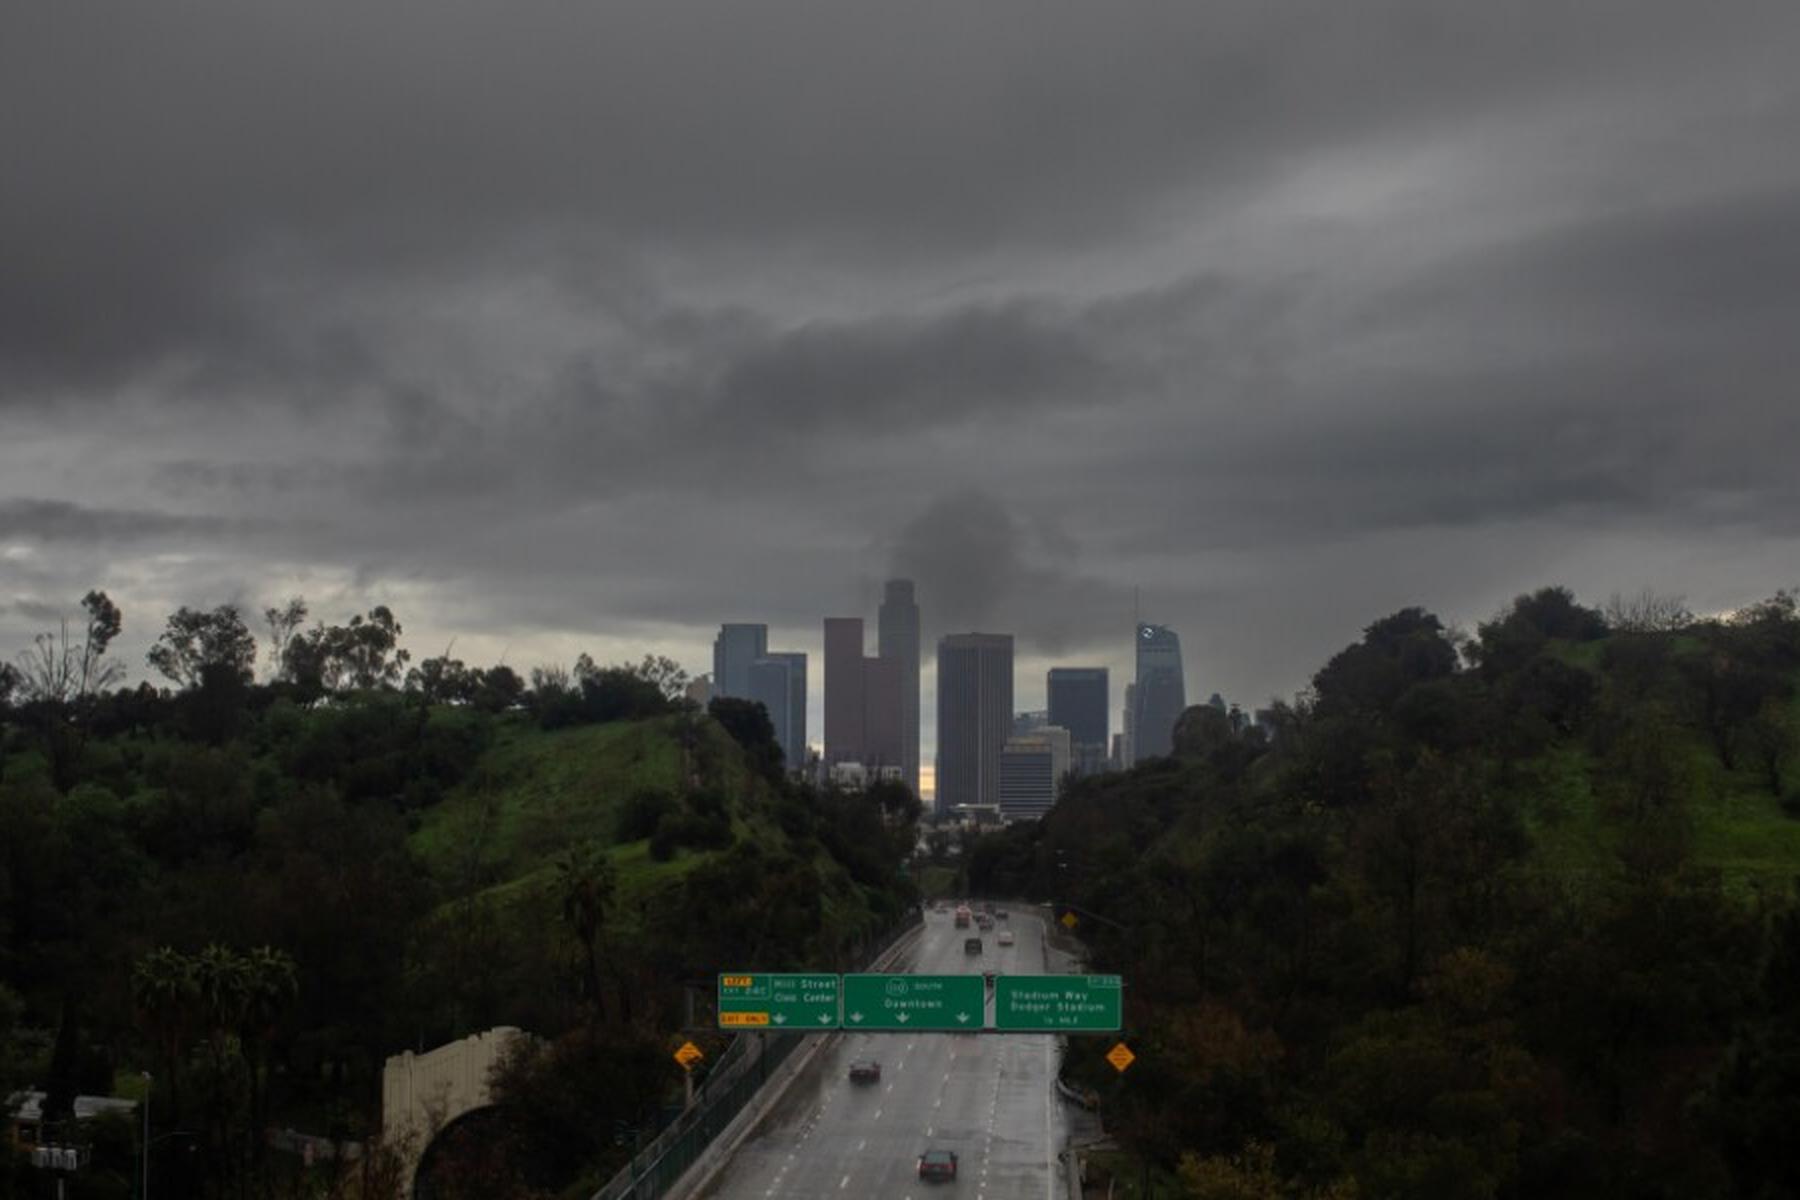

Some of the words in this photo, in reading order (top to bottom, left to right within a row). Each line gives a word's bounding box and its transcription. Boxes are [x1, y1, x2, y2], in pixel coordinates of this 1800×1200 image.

[800, 979, 836, 989] Street
[803, 993, 835, 1002] Center
[1010, 991, 1059, 1000] Stadium
[1065, 991, 1088, 1001] Way
[884, 998, 943, 1008] Downtown
[1010, 1002, 1050, 1012] Dodger
[1056, 1002, 1105, 1011] Stadium
